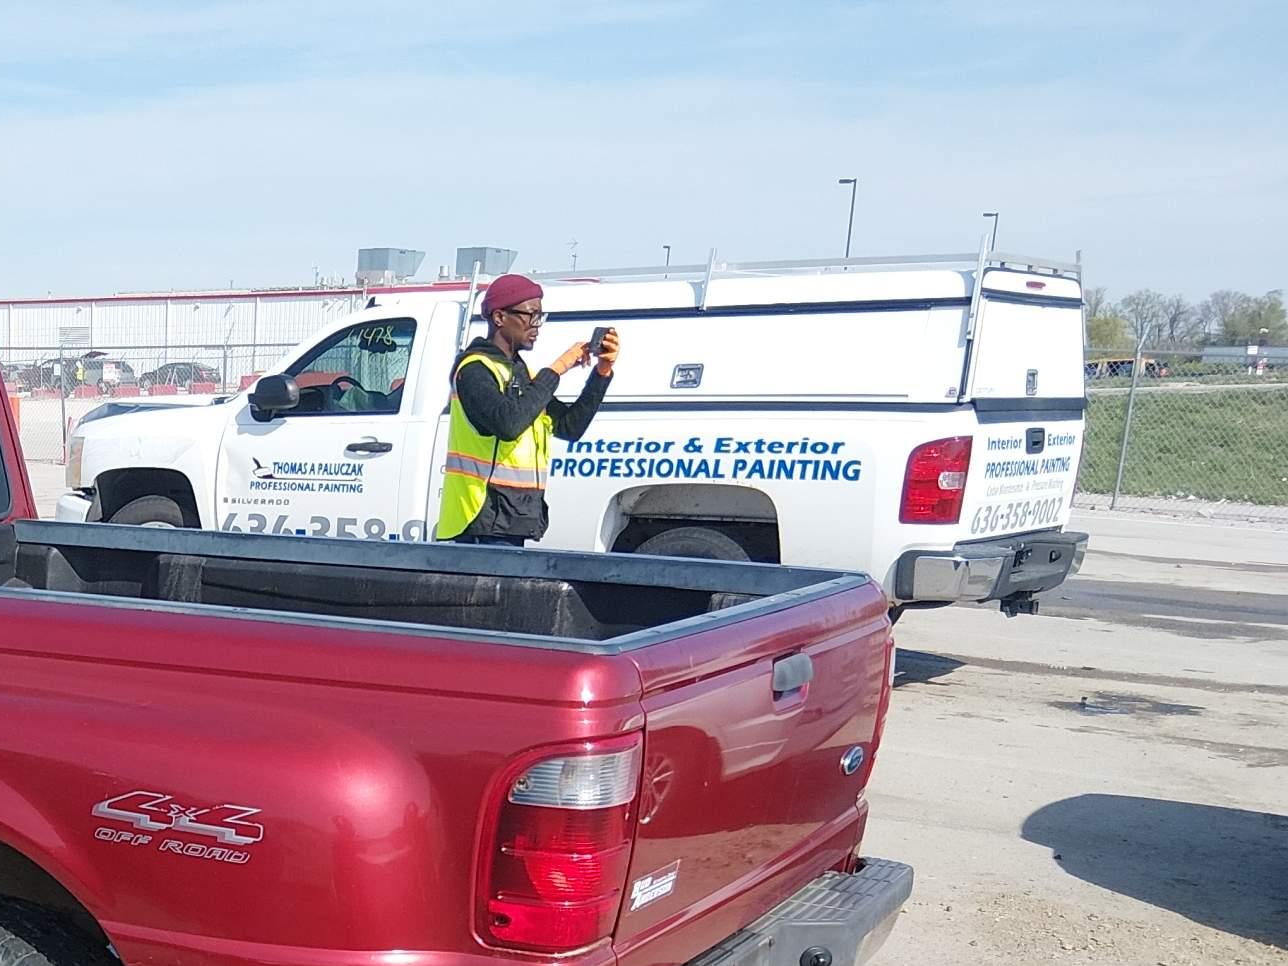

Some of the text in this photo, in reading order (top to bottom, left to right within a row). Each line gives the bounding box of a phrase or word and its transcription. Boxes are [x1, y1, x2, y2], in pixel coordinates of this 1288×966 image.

[566, 437, 845, 454] Interior & Exterior
[987, 433, 1076, 450] Interior Exterior
[272, 462, 364, 476] THOMAS A PALUCZAK
[550, 458, 862, 482] PROFESSIONAL PAINTING
[984, 456, 1070, 479] PROFESSIONAL PAINTING
[250, 481, 364, 494] PROFESSIONAL PAINTING
[231, 498, 290, 506] SILVERADO
[95, 827, 251, 864] OFF ROAD
